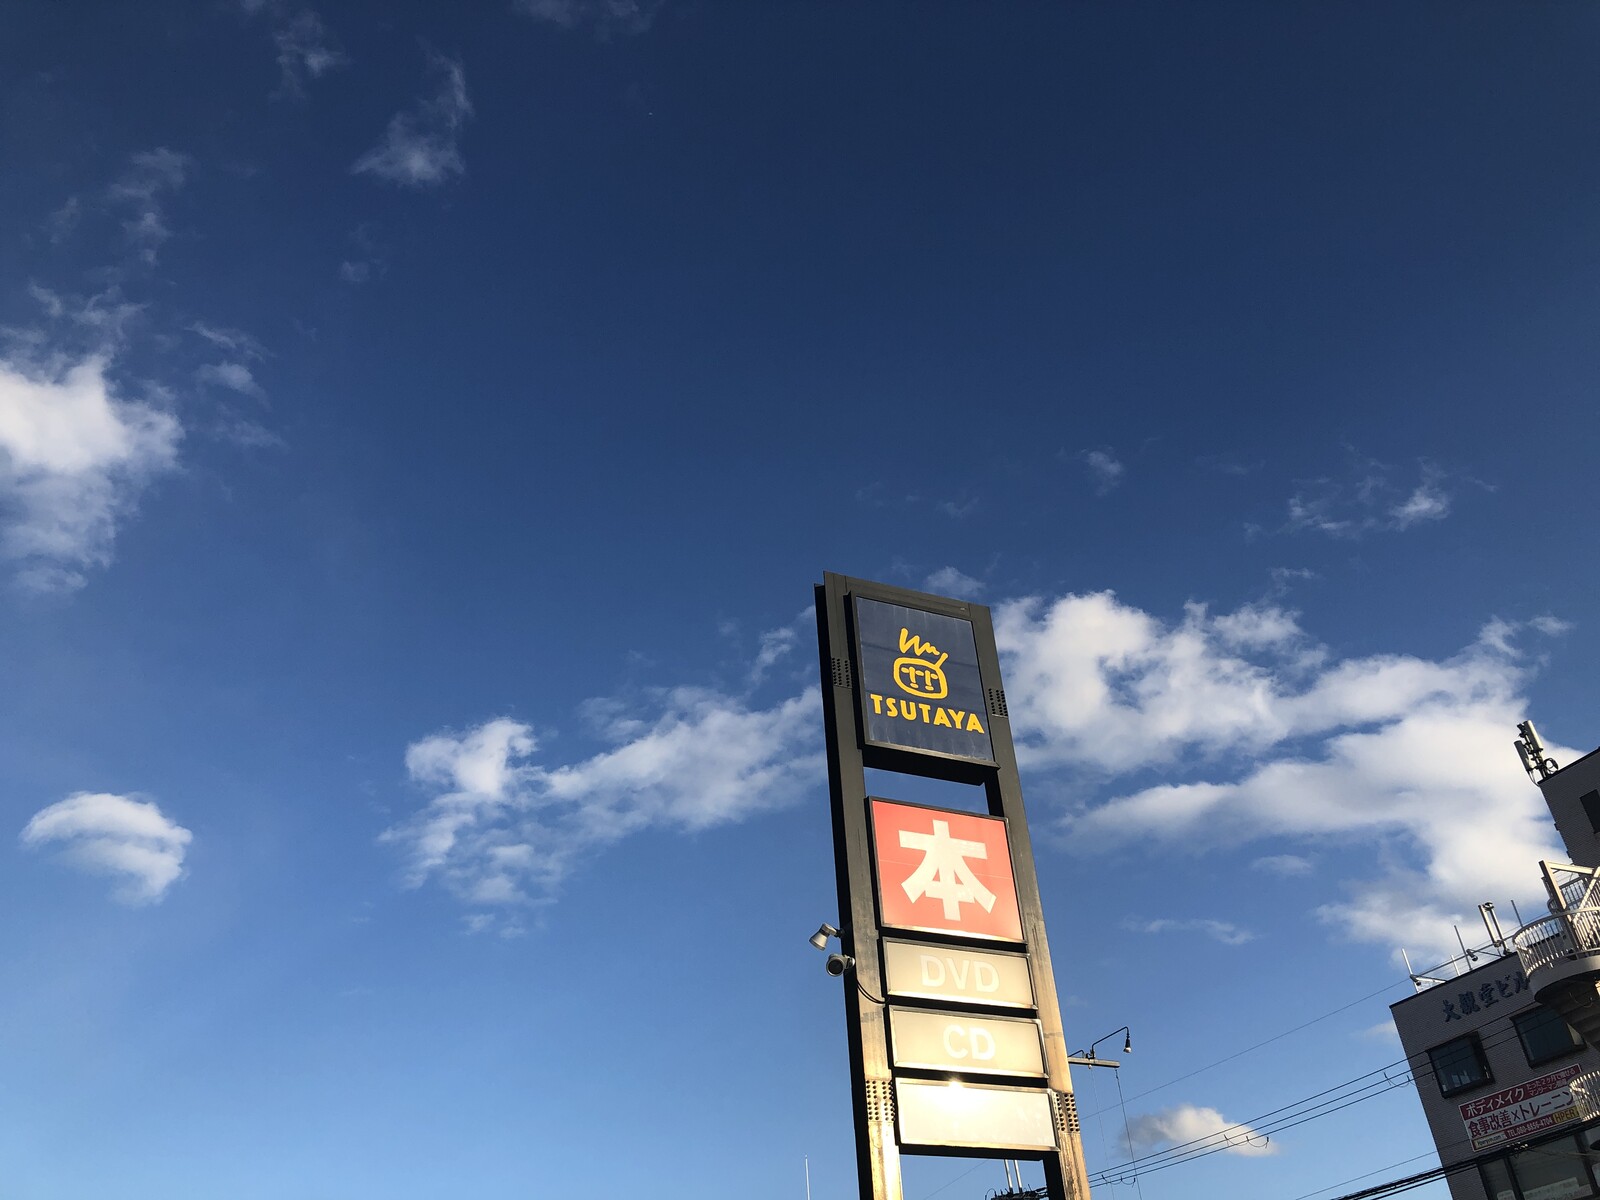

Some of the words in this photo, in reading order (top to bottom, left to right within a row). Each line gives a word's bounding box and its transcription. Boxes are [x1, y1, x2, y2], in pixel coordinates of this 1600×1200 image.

[870, 693, 985, 734] TSUTAYA
[898, 819, 997, 921] 本
[919, 954, 1000, 993] DVD
[942, 1024, 996, 1060] CD
[1466, 1087, 1524, 1117] ボディメイク
